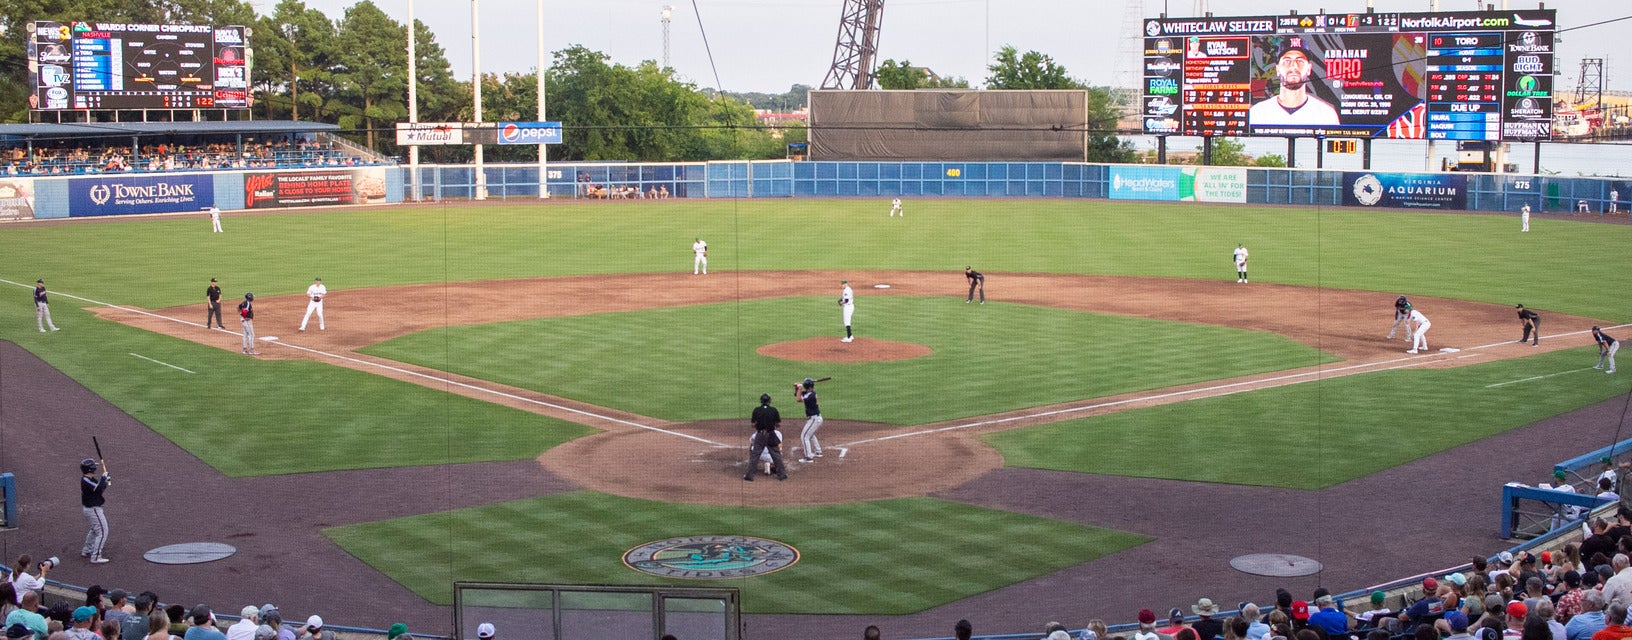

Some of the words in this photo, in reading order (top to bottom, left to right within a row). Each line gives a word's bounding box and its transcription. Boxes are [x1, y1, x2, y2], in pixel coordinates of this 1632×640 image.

[1163, 21, 1228, 34] WHITECLAW
[1229, 20, 1273, 33] SELTZER
[1401, 16, 1509, 29] NorfolkAirport.com
[96, 23, 126, 32] WARDS
[127, 24, 160, 32] CORNER
[160, 24, 211, 33] CHIROPRATIC
[1434, 38, 1442, 46] 10
[1455, 37, 1478, 45] TORO
[1324, 50, 1368, 58] ABRAHAM
[1325, 59, 1362, 80] TORO
[1514, 64, 1543, 72] LIGHT
[216, 90, 245, 99] Canon
[416, 132, 452, 141] Mutual
[521, 126, 557, 140] pepsi
[946, 168, 961, 177] 400
[1514, 181, 1530, 189] 375
[1388, 186, 1456, 196] AQUARIUM
[665, 569, 757, 578] TIDES
